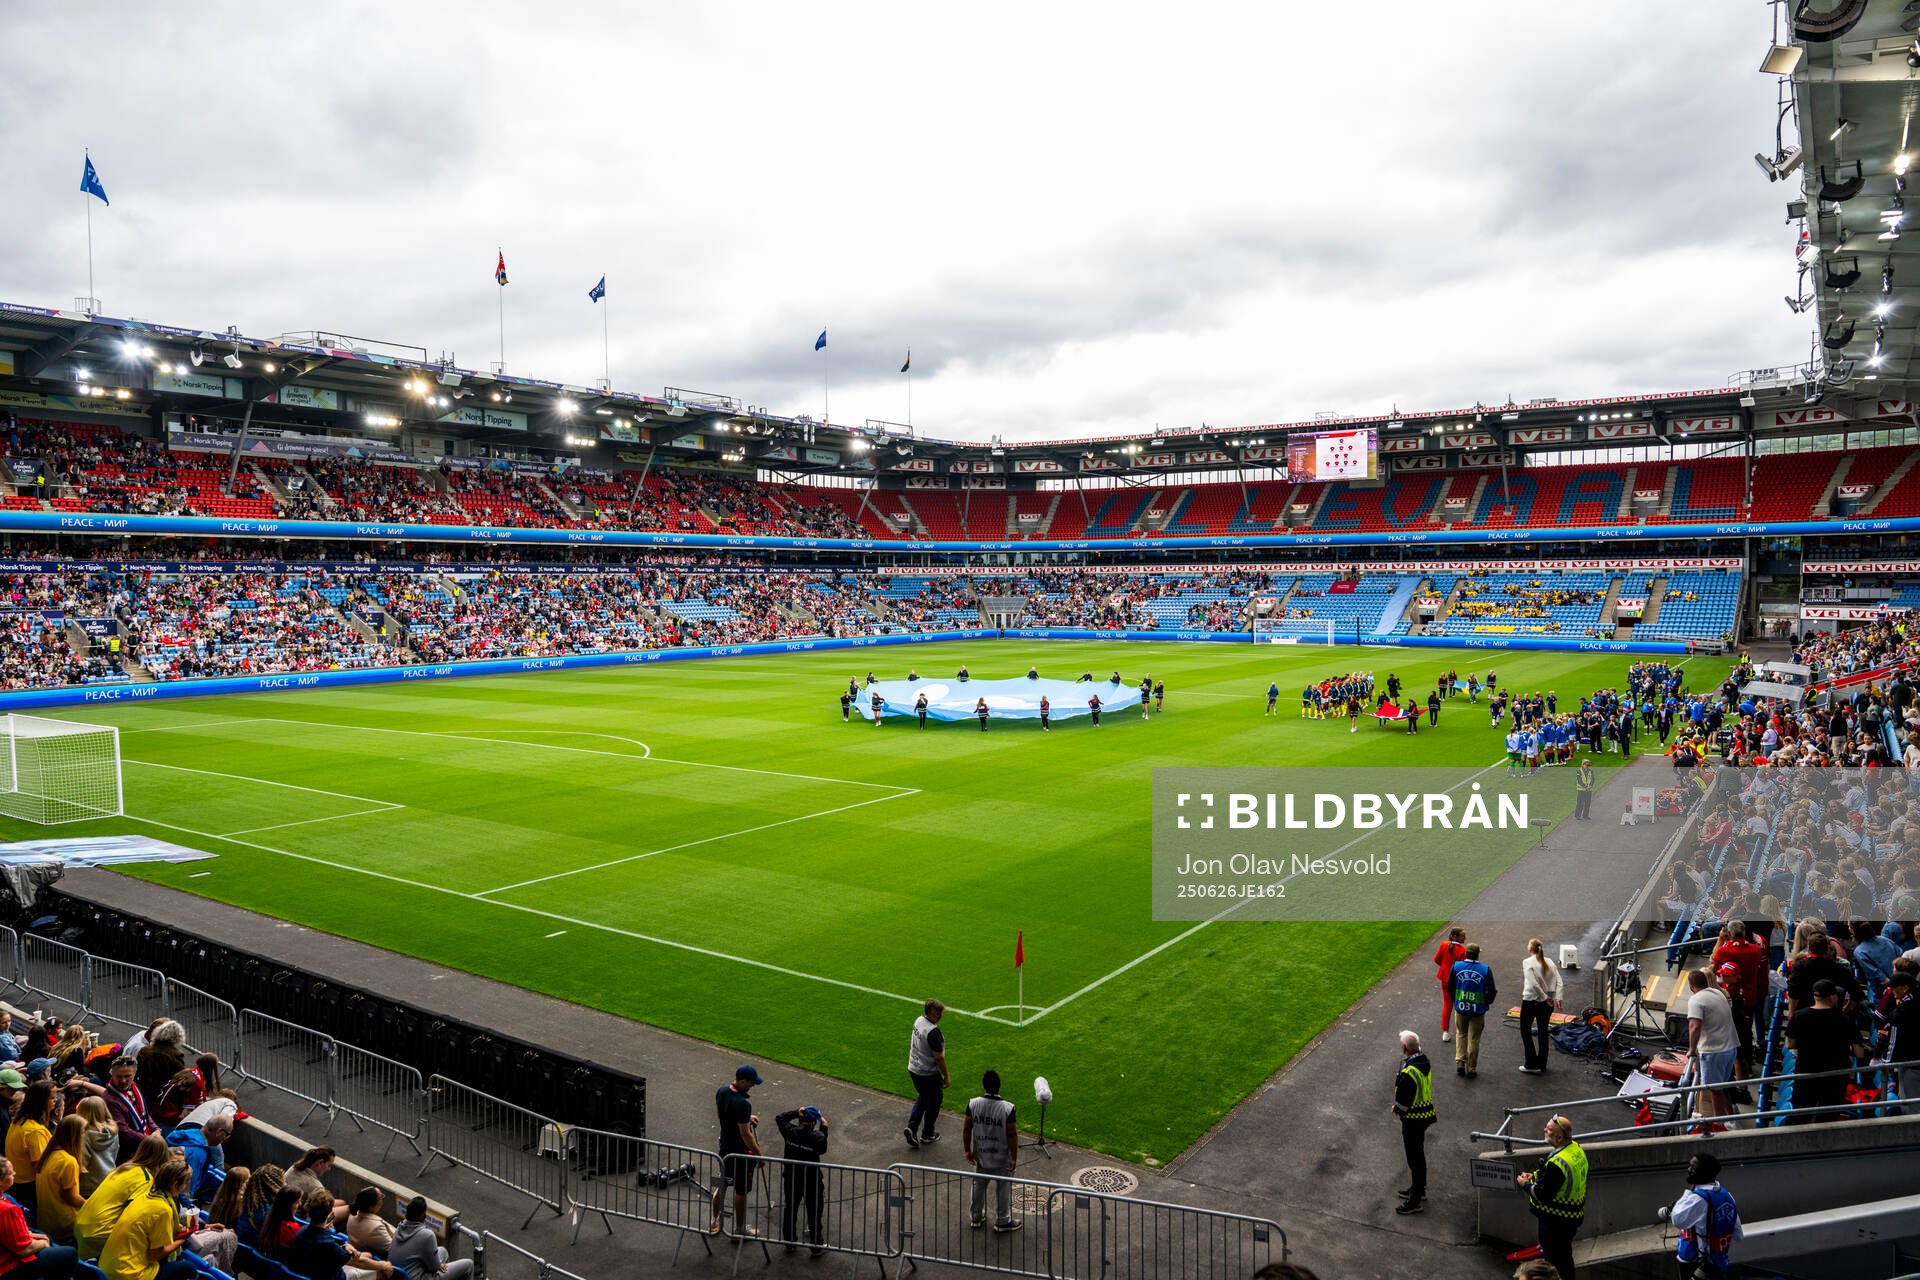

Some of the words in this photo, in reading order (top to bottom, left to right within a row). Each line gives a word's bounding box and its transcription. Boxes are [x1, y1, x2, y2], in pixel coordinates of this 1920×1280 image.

[183, 380, 202, 389] Norsk
[465, 412, 485, 422] Nors
[486, 414, 513, 427] Tipping
[1775, 409, 1834, 425] VG
[1673, 416, 1733, 433] VG
[1514, 429, 1566, 443] VG
[1594, 424, 1649, 438] VG
[212, 439, 233, 447] Tipping
[1444, 434, 1495, 448] VG
[1187, 451, 1227, 463] VG
[1243, 447, 1285, 459] VG
[1134, 455, 1173, 466] VG
[1394, 456, 1443, 469] VG
[1461, 453, 1513, 467] VG
[952, 462, 989, 472] VG
[1019, 461, 1058, 472] VG
[908, 478, 947, 488] VG
[963, 478, 1004, 488] VG
[1839, 485, 1871, 494] VG
[60, 518, 95, 527] PEACE
[104, 519, 129, 528] МИР
[222, 523, 250, 532] PEACE
[257, 524, 278, 532] МИР
[1842, 522, 1867, 530] PEACE
[1872, 521, 1891, 529] МИР
[356, 527, 381, 535] PEACE
[1513, 532, 1531, 540] МИР
[1805, 564, 1837, 572] VG
[1841, 564, 1873, 572] VG
[1876, 563, 1906, 571] VG
[1806, 609, 1840, 618] VG
[1849, 610, 1879, 618] VG
[1579, 642, 1603, 650] PEACE
[1608, 642, 1628, 650] МИР
[624, 655, 642, 663] PEACE
[522, 661, 544, 670] PEACE
[549, 661, 565, 669] МИР
[403, 669, 428, 678] PEACE
[434, 669, 453, 677] МИР
[259, 678, 289, 688] PEACE
[298, 676, 320, 686] МИР
[84, 688, 121, 700] PEACE
[131, 686, 158, 698] МИР
[1457, 971, 1483, 985] UEFA
[1458, 1002, 1477, 1013] 031
[973, 1115, 1003, 1127] ARENA
